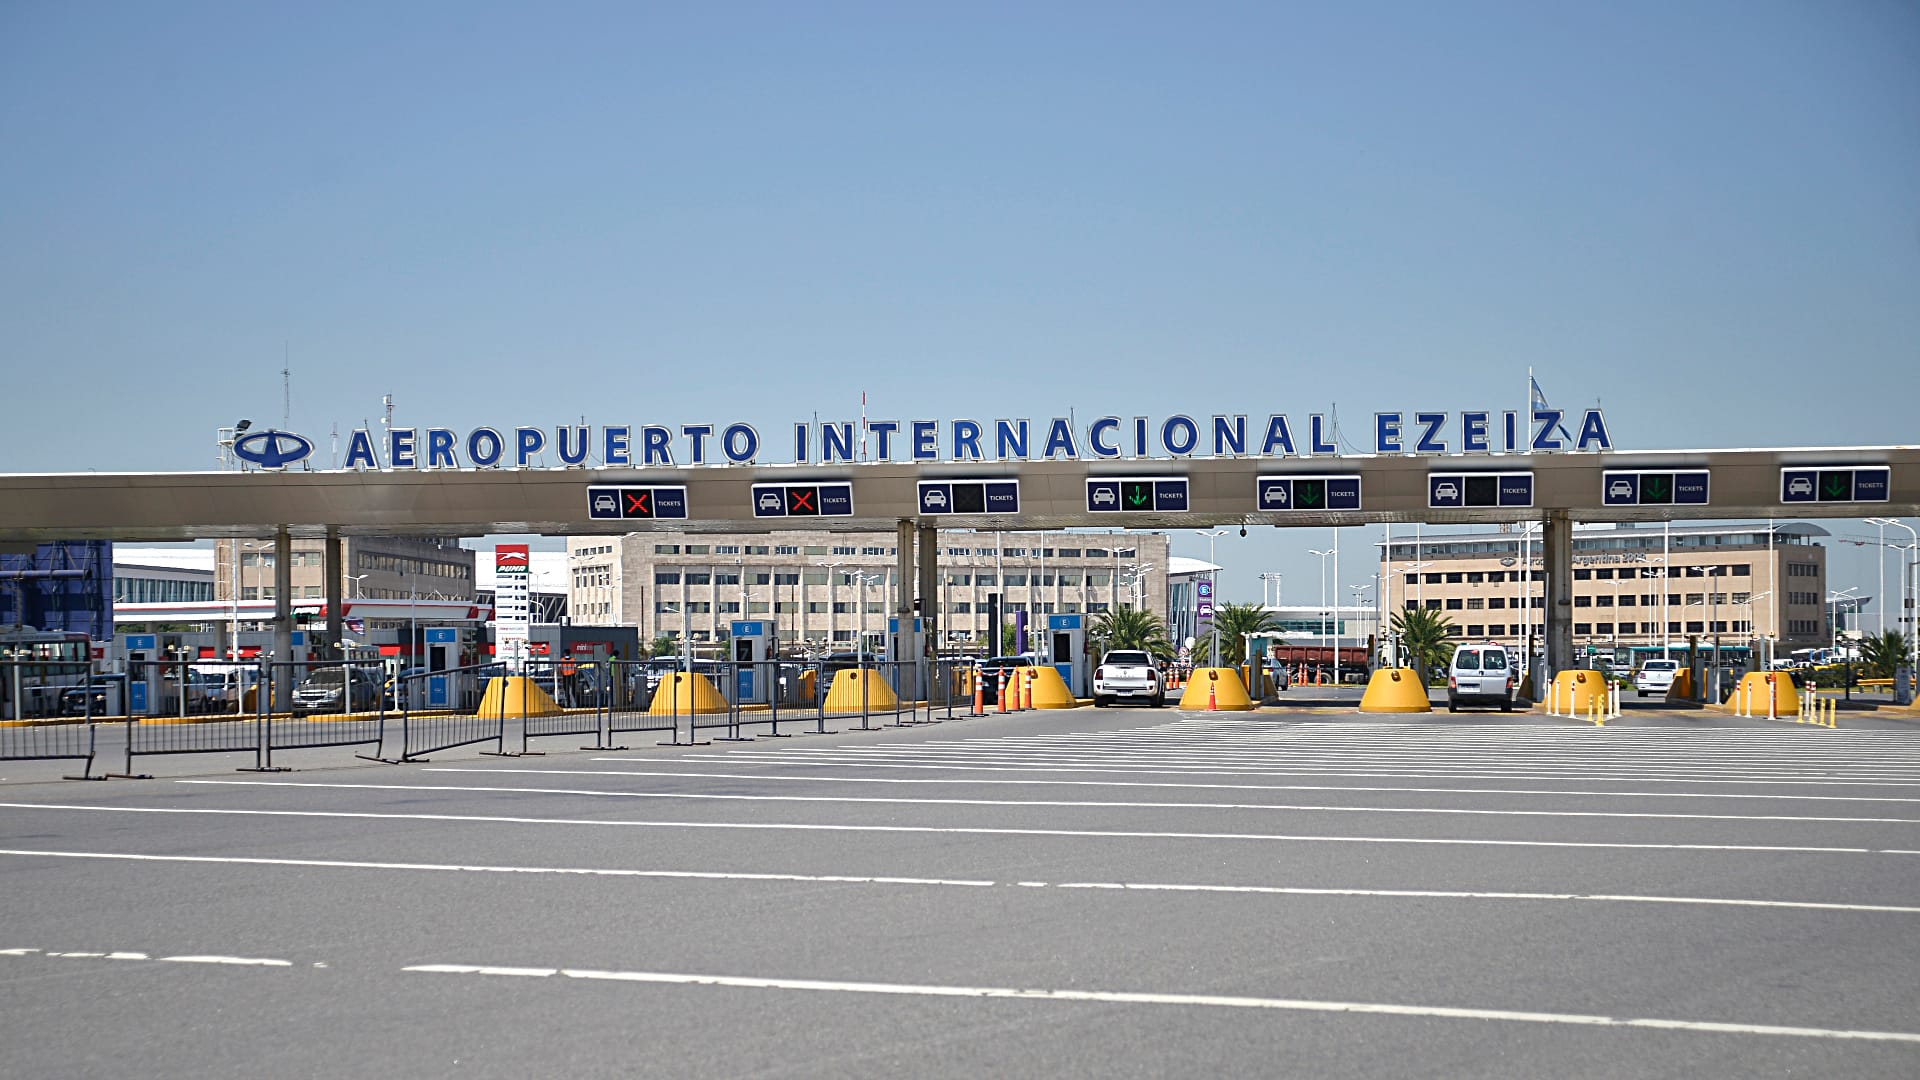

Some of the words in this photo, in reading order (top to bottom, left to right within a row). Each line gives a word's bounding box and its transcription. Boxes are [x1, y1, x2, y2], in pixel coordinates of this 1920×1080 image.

[344, 422, 761, 470] AEROPUERTO
[794, 414, 1339, 464] INTERNACIONAL
[1374, 408, 1615, 456] EZEIZA
